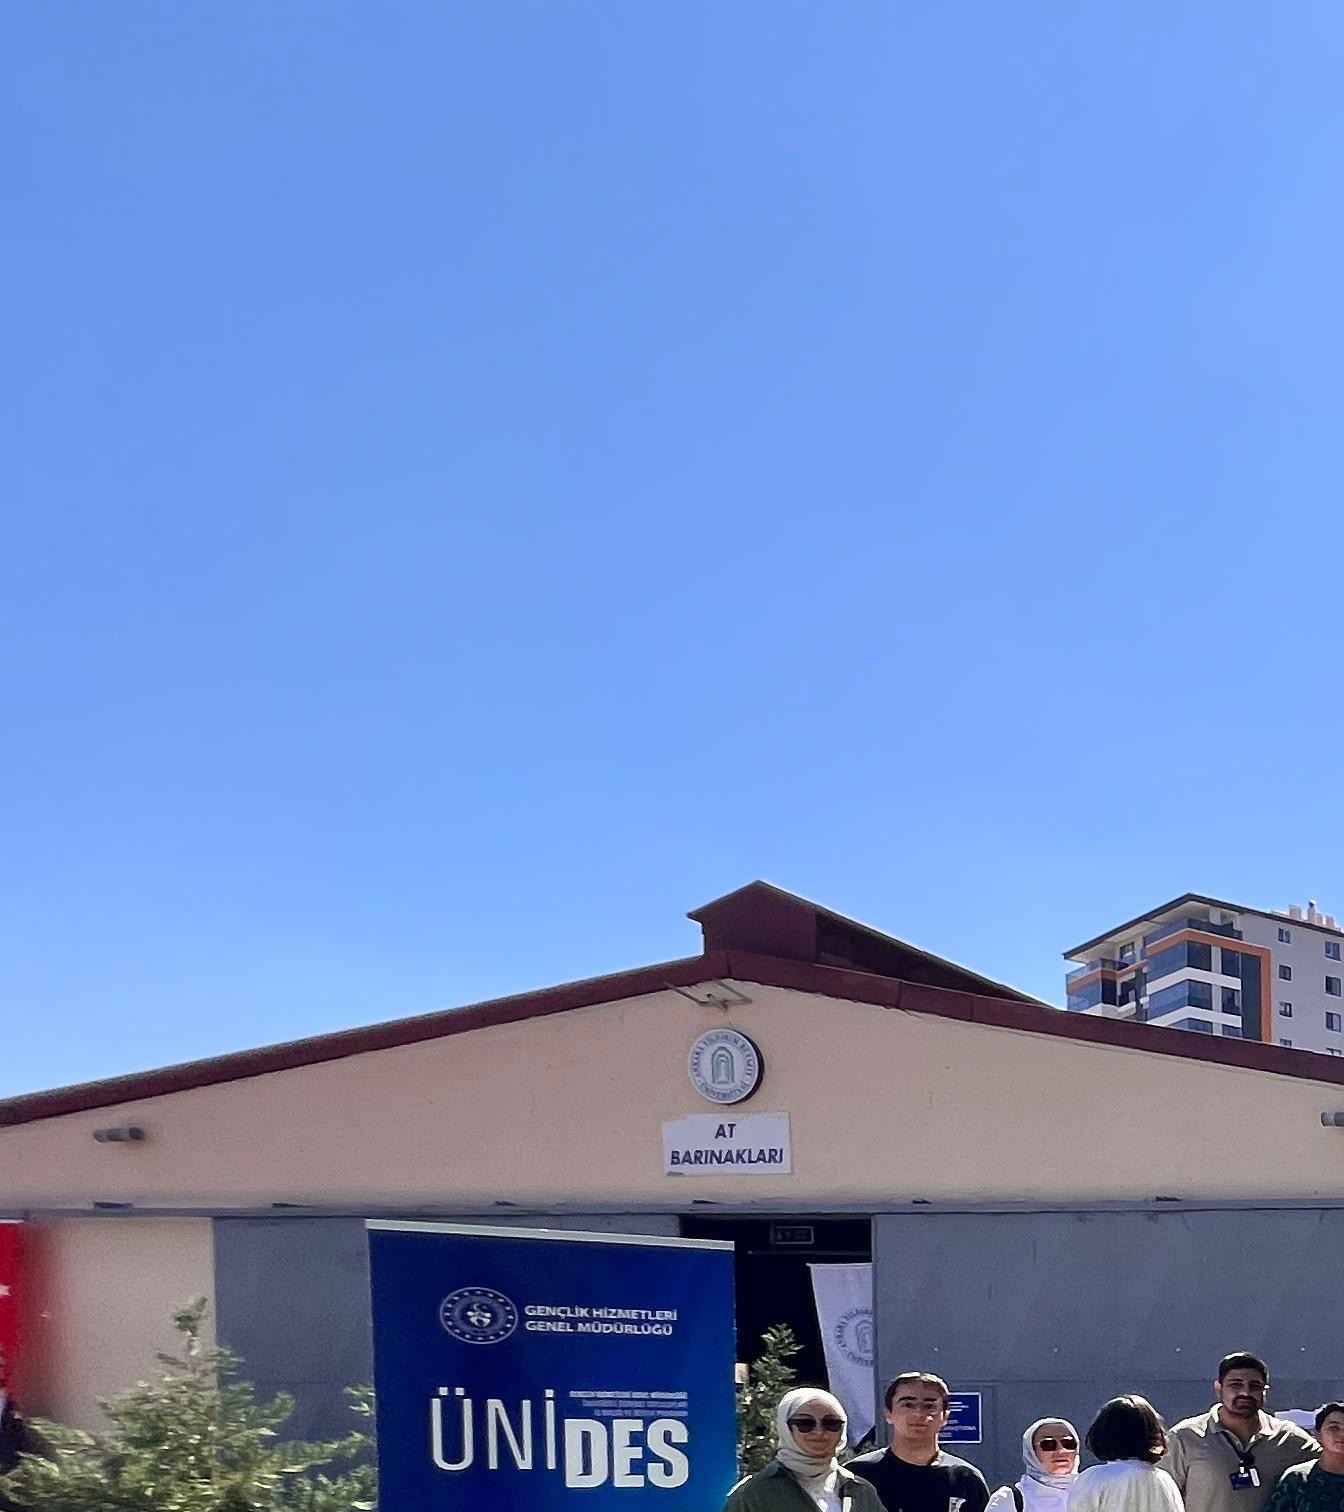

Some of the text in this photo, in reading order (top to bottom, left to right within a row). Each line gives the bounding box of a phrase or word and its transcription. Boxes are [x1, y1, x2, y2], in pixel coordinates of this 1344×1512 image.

[714, 1123, 737, 1139] AT
[670, 1147, 784, 1166] BARINAKLARI
[524, 1305, 678, 1321] GENÇLİK HİZMETLERİ
[525, 1320, 673, 1336] GENEL MÜDÜRLÜĞÜ
